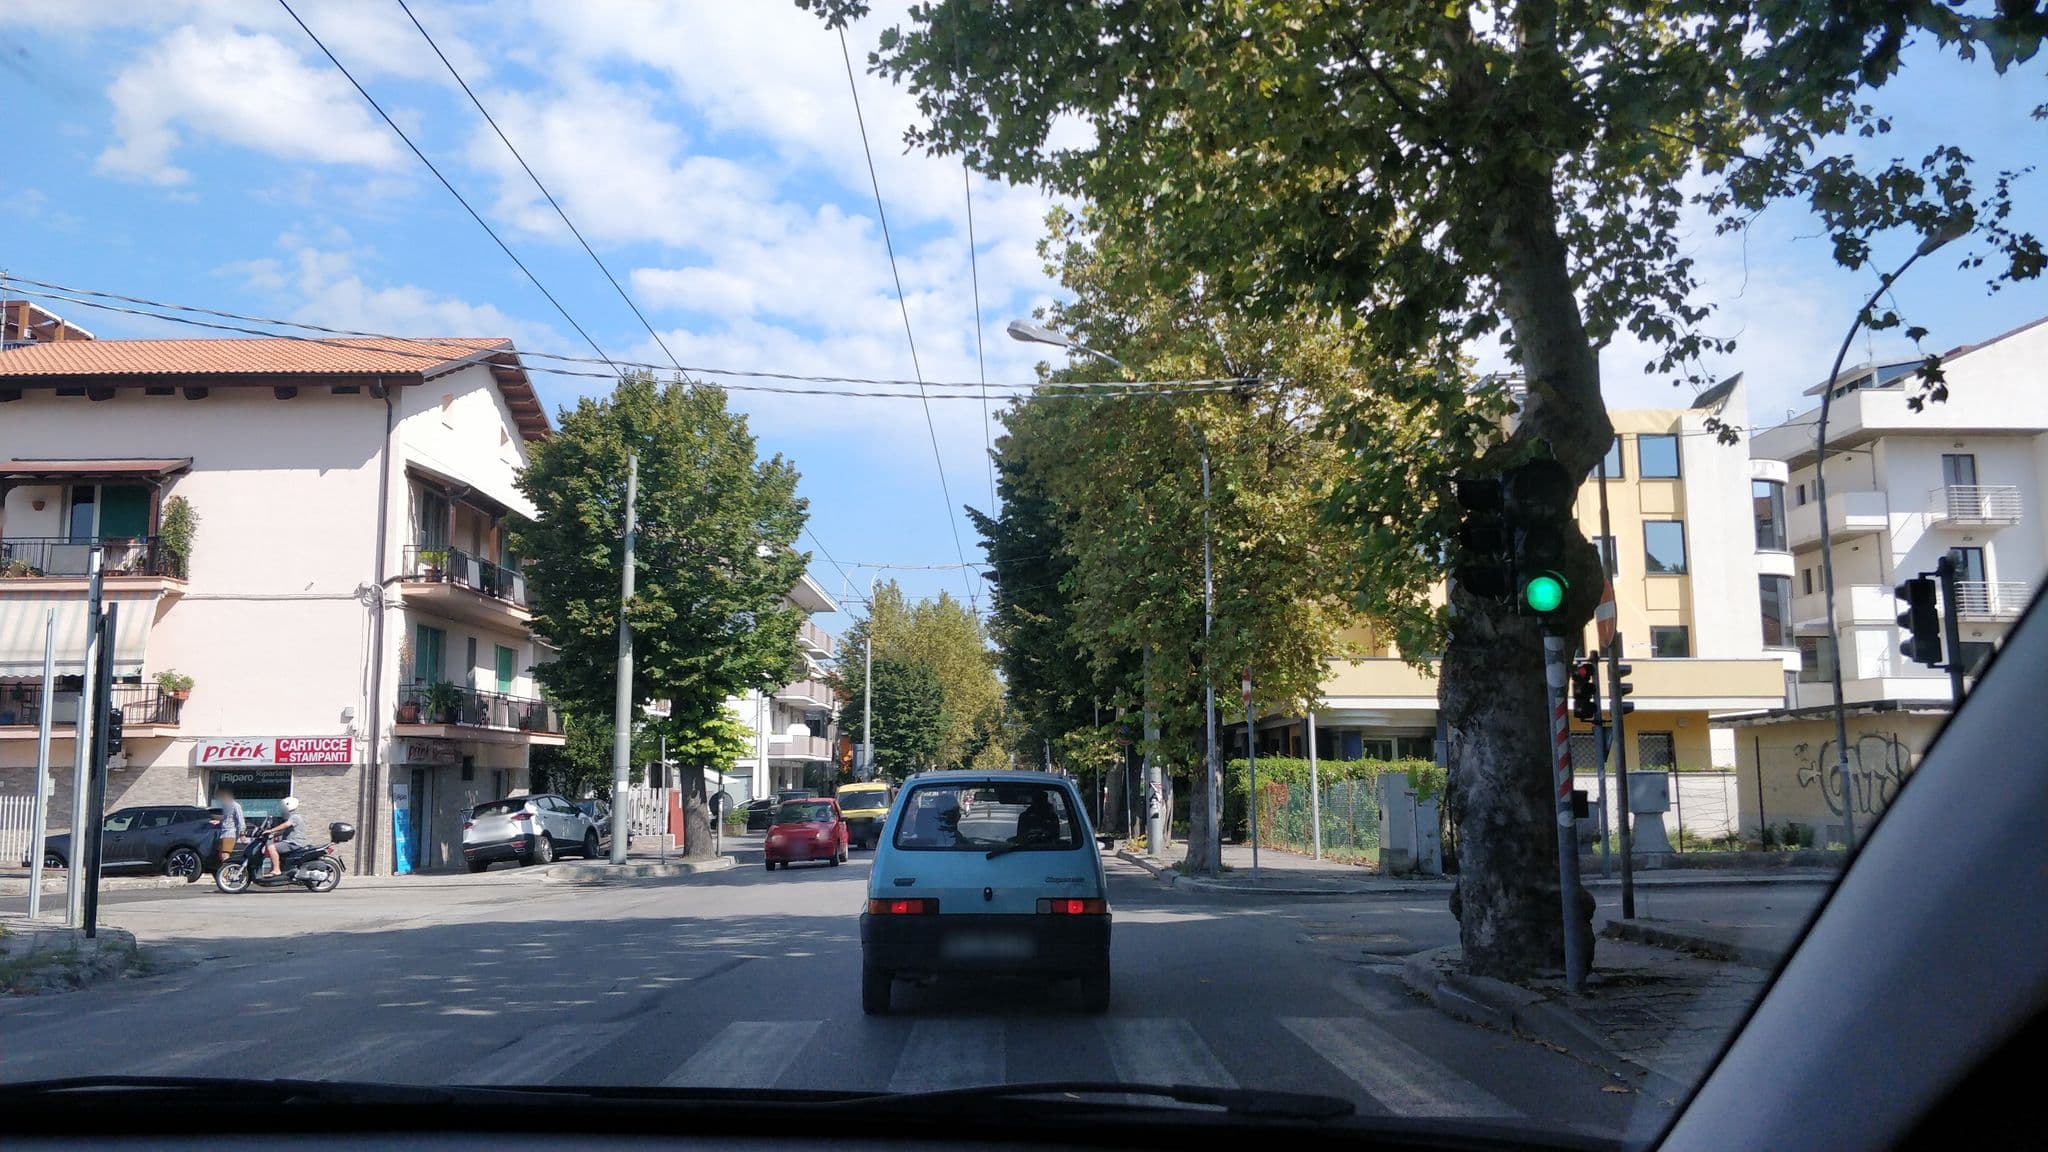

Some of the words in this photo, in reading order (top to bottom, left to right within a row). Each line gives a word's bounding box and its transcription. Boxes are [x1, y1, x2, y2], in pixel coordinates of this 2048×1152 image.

[280, 739, 348, 751] CARTUCCE
[202, 742, 269, 763] prink
[289, 752, 348, 763] STAMPANTI
[221, 773, 254, 783] iRiparo
